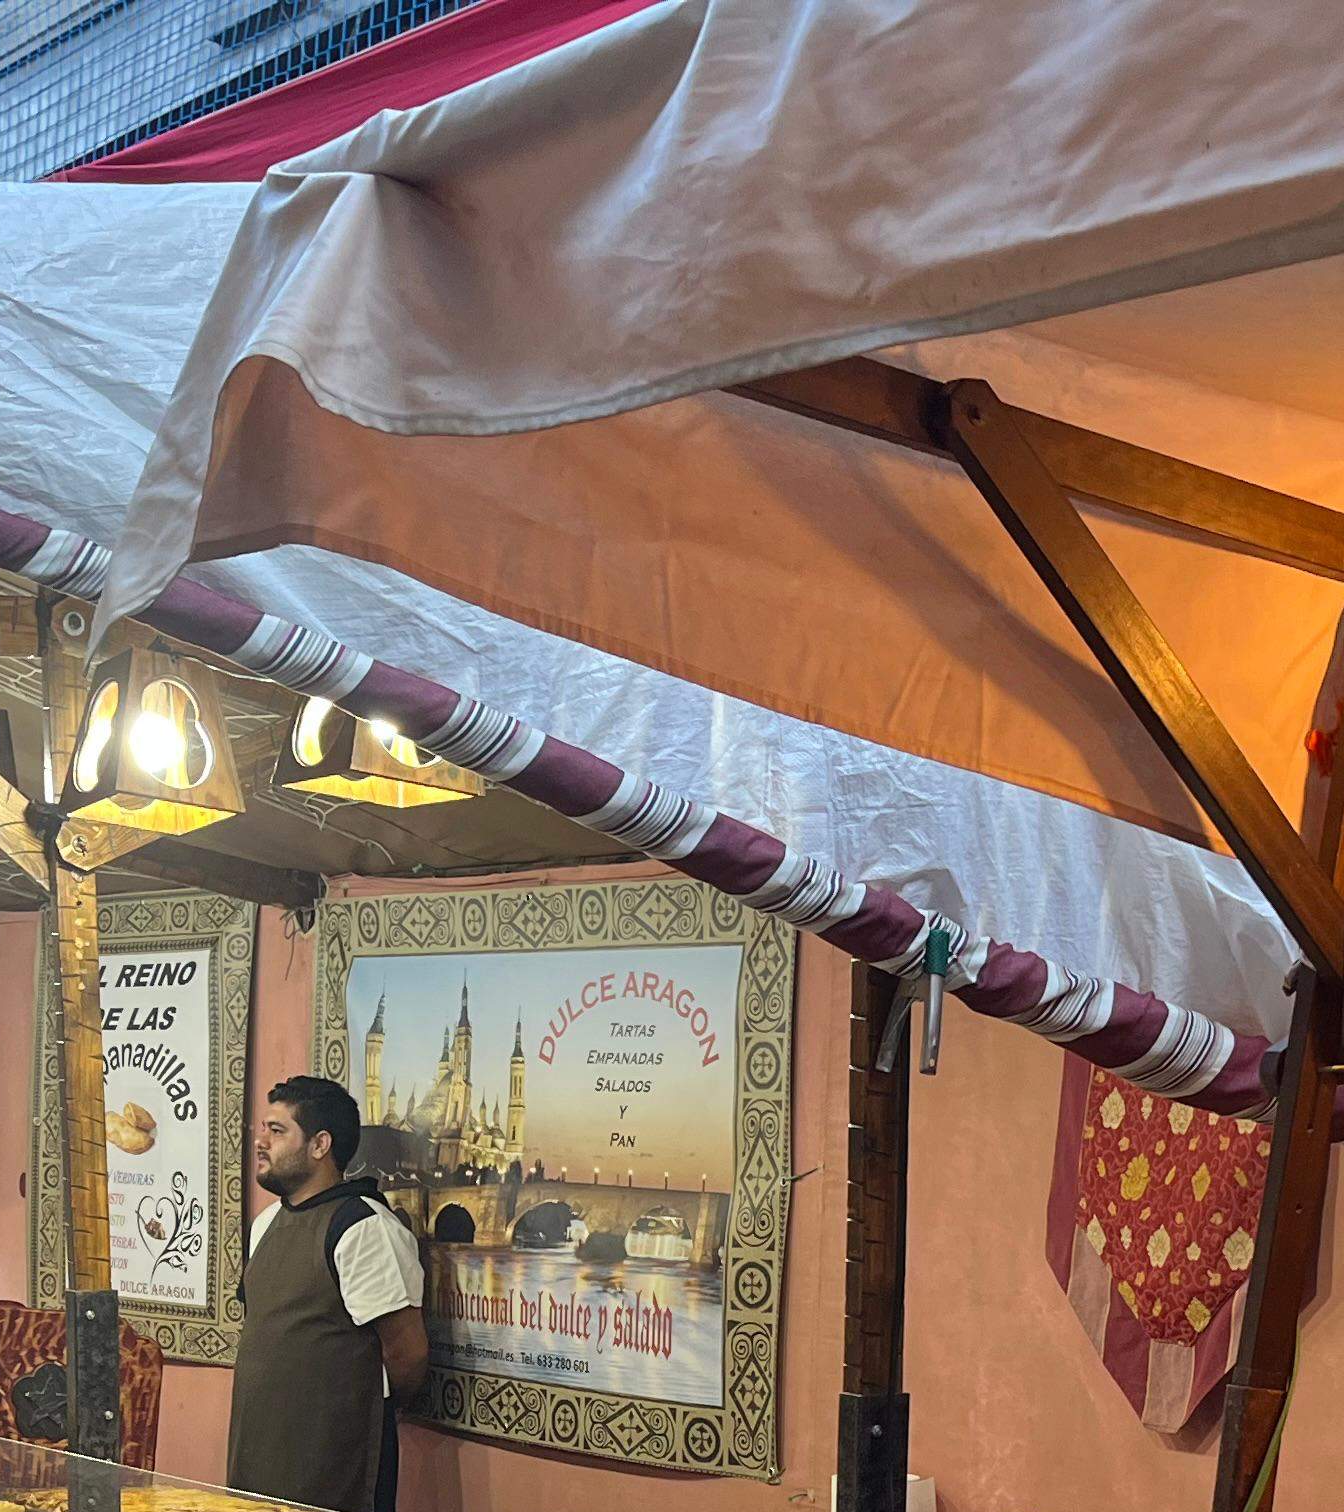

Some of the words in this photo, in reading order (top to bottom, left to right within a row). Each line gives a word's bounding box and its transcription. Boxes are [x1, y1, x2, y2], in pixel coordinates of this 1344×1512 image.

[115, 961, 197, 988] REINO
[126, 1006, 177, 1031] LAS
[538, 973, 617, 1066] DULCE
[621, 971, 720, 1068] ARAGON
[102, 1042, 198, 1122] panadillas
[619, 1104, 629, 1120] Y
[120, 1280, 149, 1295] DULCE
[151, 1286, 196, 1300] ARAGON
[520, 1289, 544, 1332] del
[548, 1291, 592, 1340] dulce
[596, 1303, 608, 1355] y
[612, 1288, 674, 1361] salado
[521, 1351, 535, 1366] Tel.
[537, 1354, 553, 1369] 633
[555, 1356, 572, 1371] 280
[573, 1359, 590, 1374] 601
